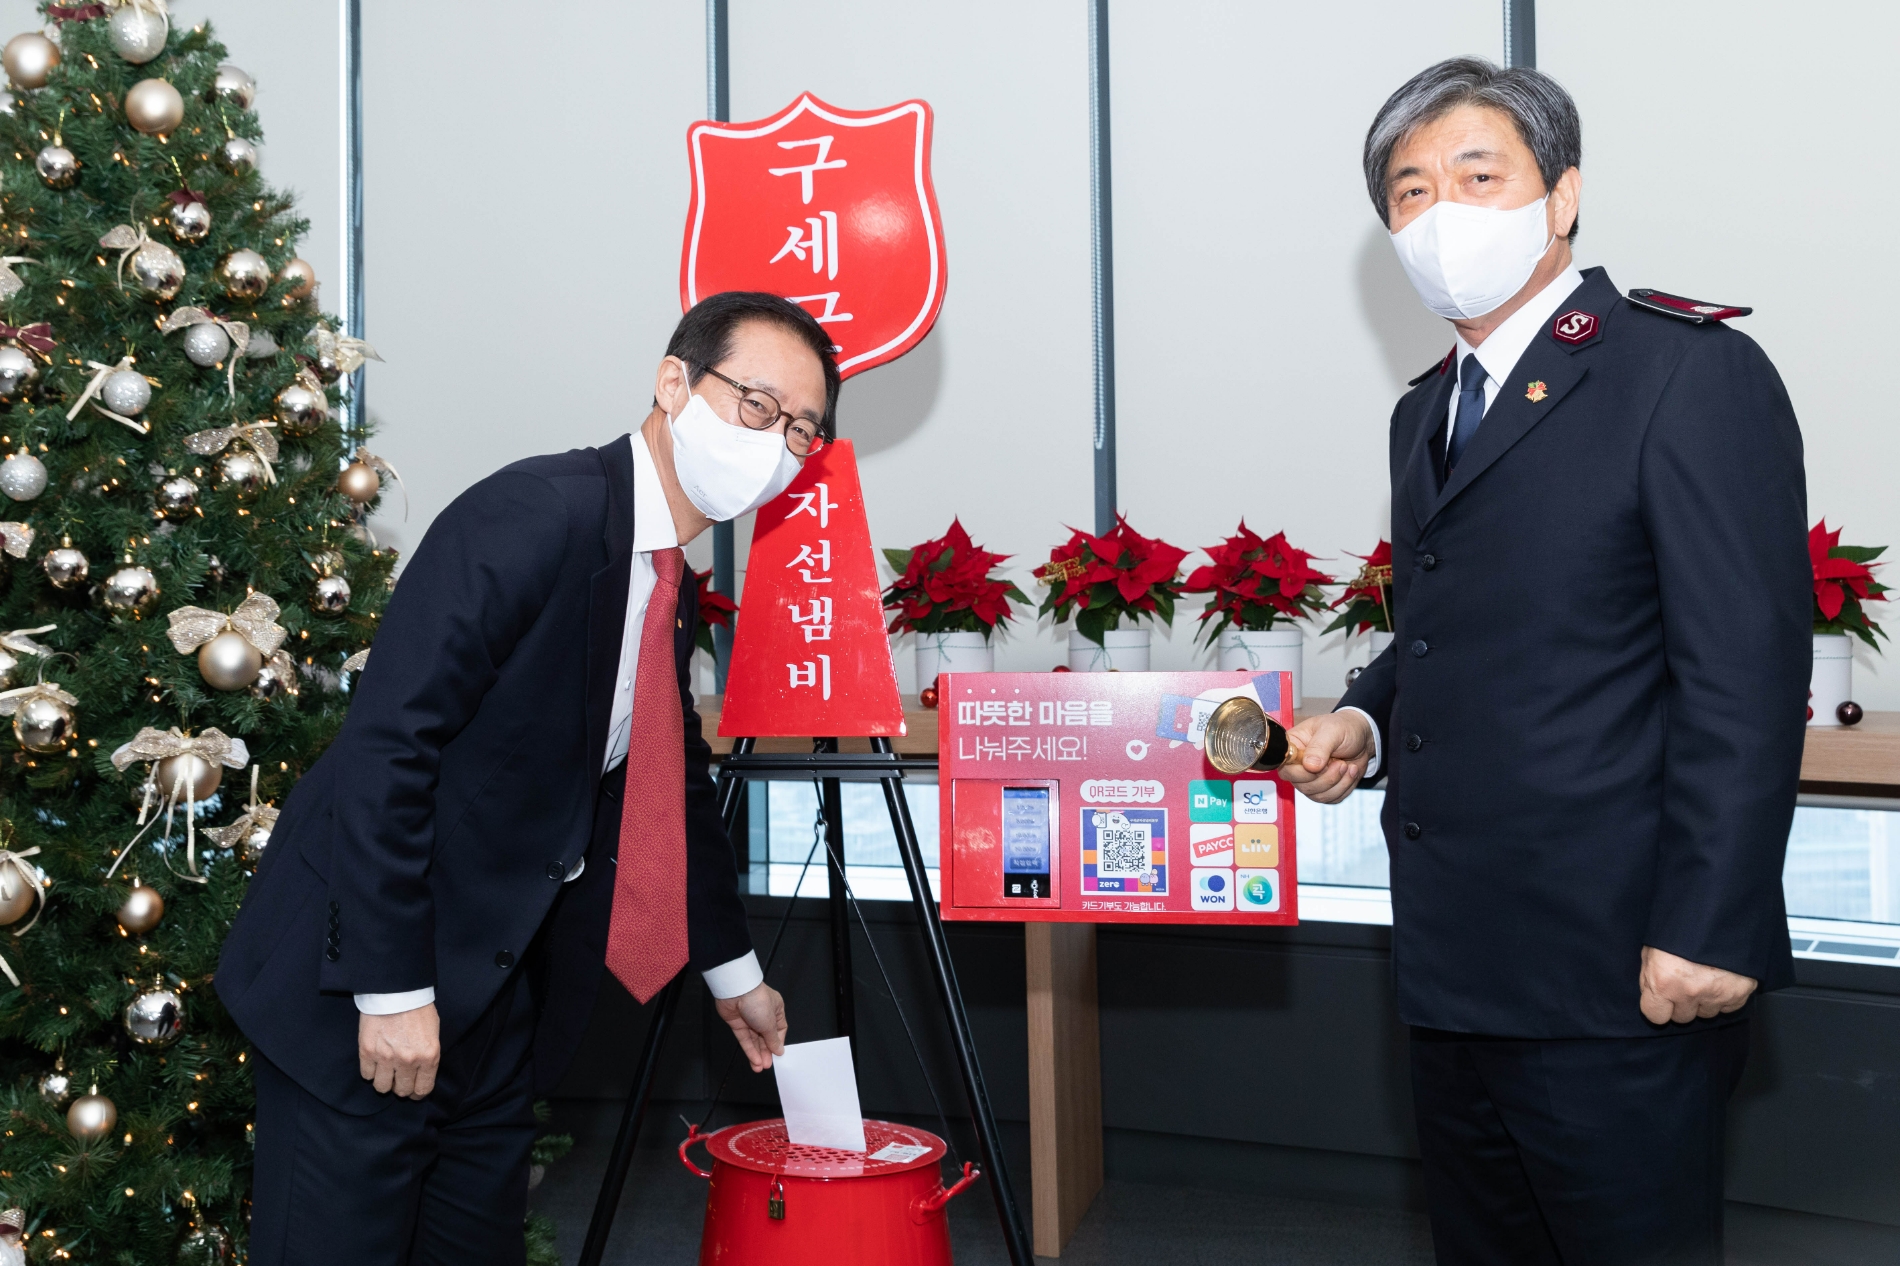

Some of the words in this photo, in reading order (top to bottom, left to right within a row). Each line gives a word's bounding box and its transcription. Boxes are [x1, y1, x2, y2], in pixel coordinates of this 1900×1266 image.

[1559, 314, 1588, 335] S
[784, 482, 839, 701] 자선냄비
[958, 700, 1033, 726] 따뜻한
[1039, 700, 1114, 726] 마음을
[958, 735, 1087, 761] 나눠주세요!
[1089, 785, 1128, 799] QR코드
[1132, 785, 1155, 798] 기부
[1209, 796, 1228, 808] Pay
[1082, 901, 1122, 911] 카드기부도
[1124, 901, 1167, 912] 가능합니다.
[1200, 895, 1226, 903] WON
